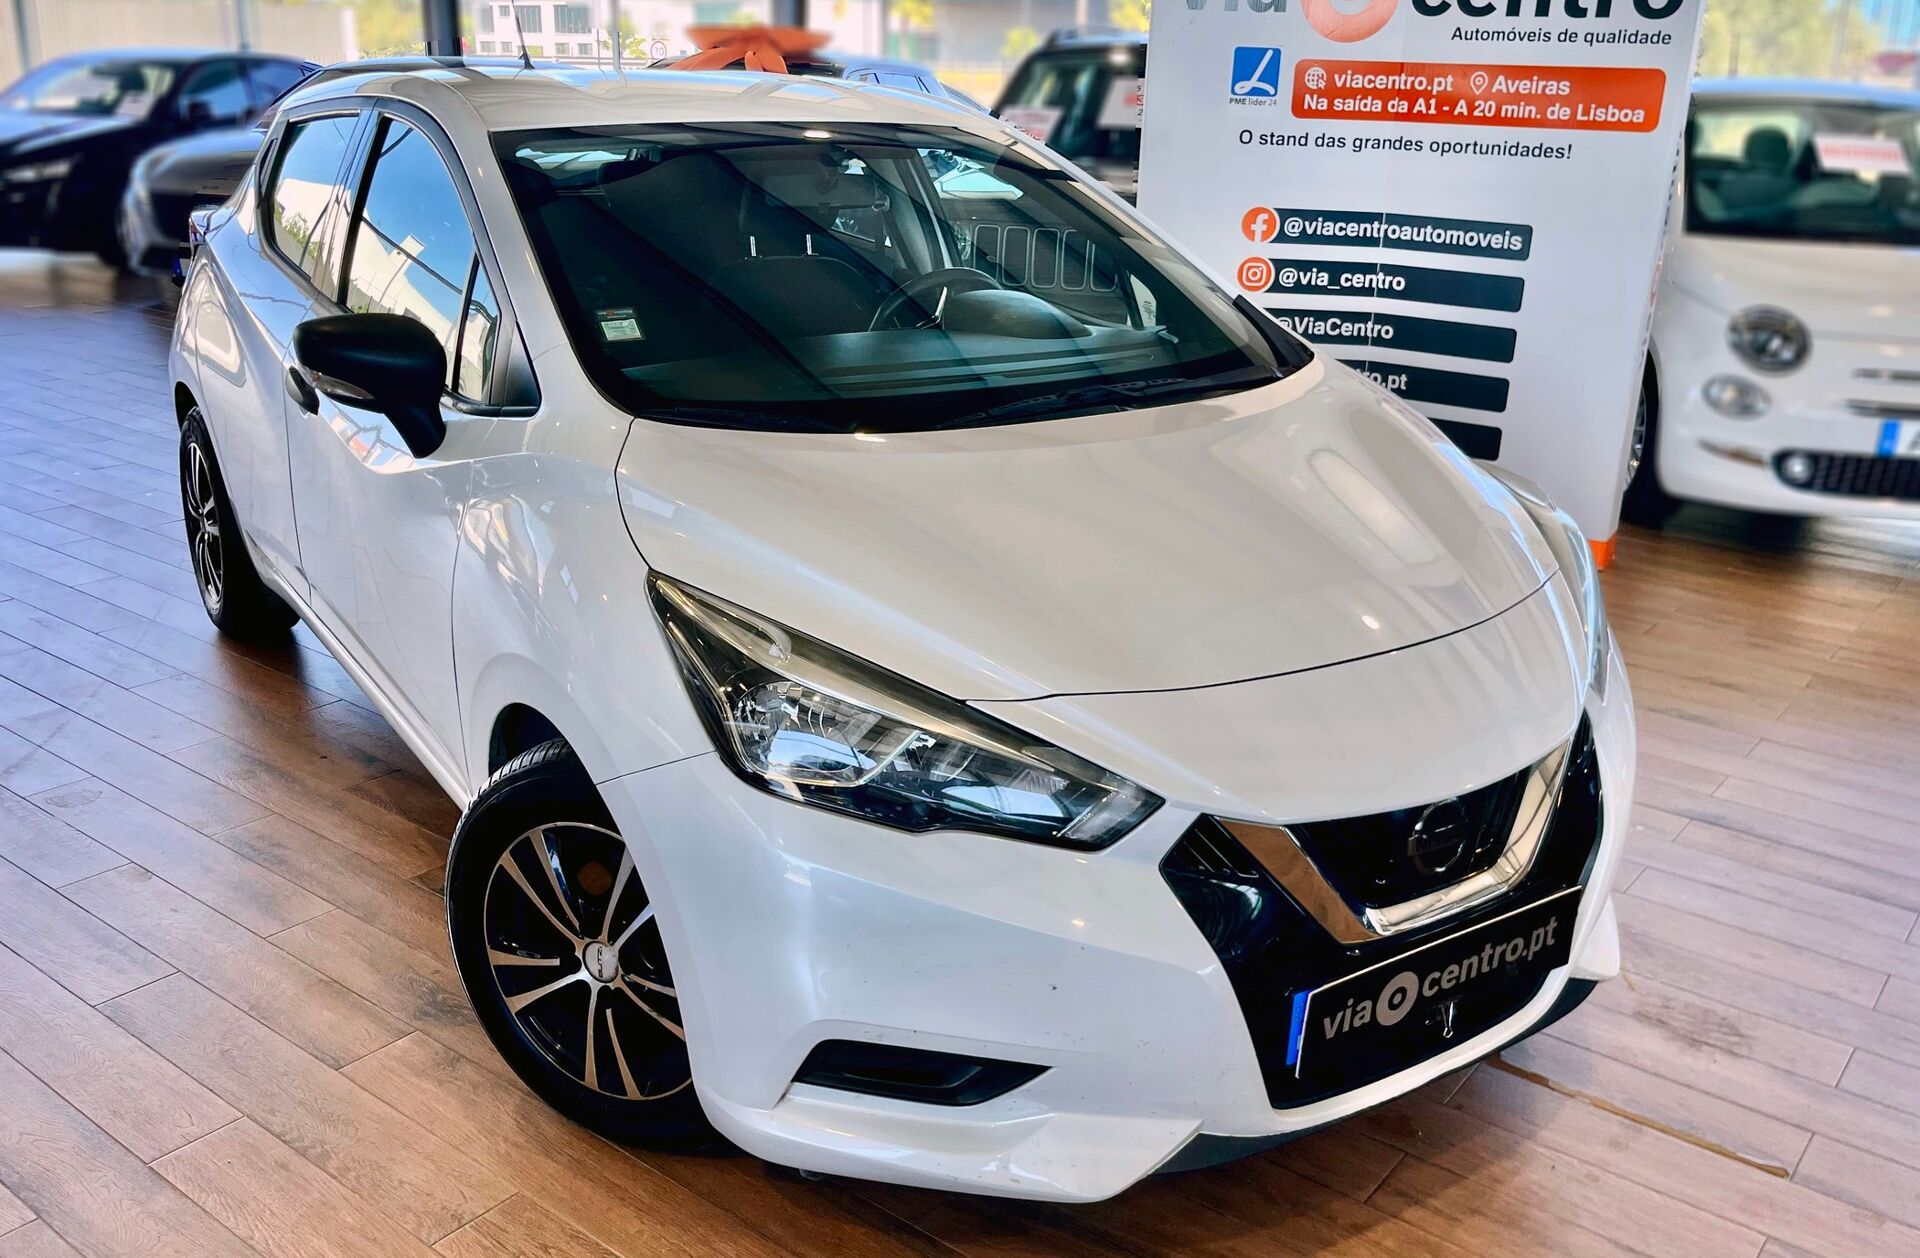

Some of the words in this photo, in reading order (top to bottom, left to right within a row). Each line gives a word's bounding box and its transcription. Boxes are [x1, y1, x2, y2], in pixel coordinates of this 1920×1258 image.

[1451, 26, 1551, 43] Automóveis
[1557, 29, 1578, 43] de
[1583, 30, 1672, 46] qualidade
[1334, 70, 1453, 95] viacentro.pt
[1491, 75, 1571, 96] Aveiras
[1229, 97, 1246, 105] PME
[1303, 93, 1328, 111] Na
[1333, 95, 1382, 113] saída
[1387, 97, 1408, 114] da
[1412, 98, 1437, 115] A1
[1453, 100, 1468, 116] A
[1473, 100, 1496, 117] 20
[1500, 101, 1541, 120] min.
[1546, 103, 1571, 120] de
[1576, 104, 1645, 123] Lisboa
[1239, 129, 1253, 145] O
[1258, 132, 1309, 148] stand
[1314, 133, 1346, 149] das
[1352, 136, 1423, 153] grandes
[1429, 140, 1573, 160] oportunidades!
[1284, 217, 1523, 250] @viacentroautomoveis
[1278, 267, 1406, 293] @via_centro
[1323, 999, 1371, 1039] via
[1422, 916, 1557, 997] centro.pt
